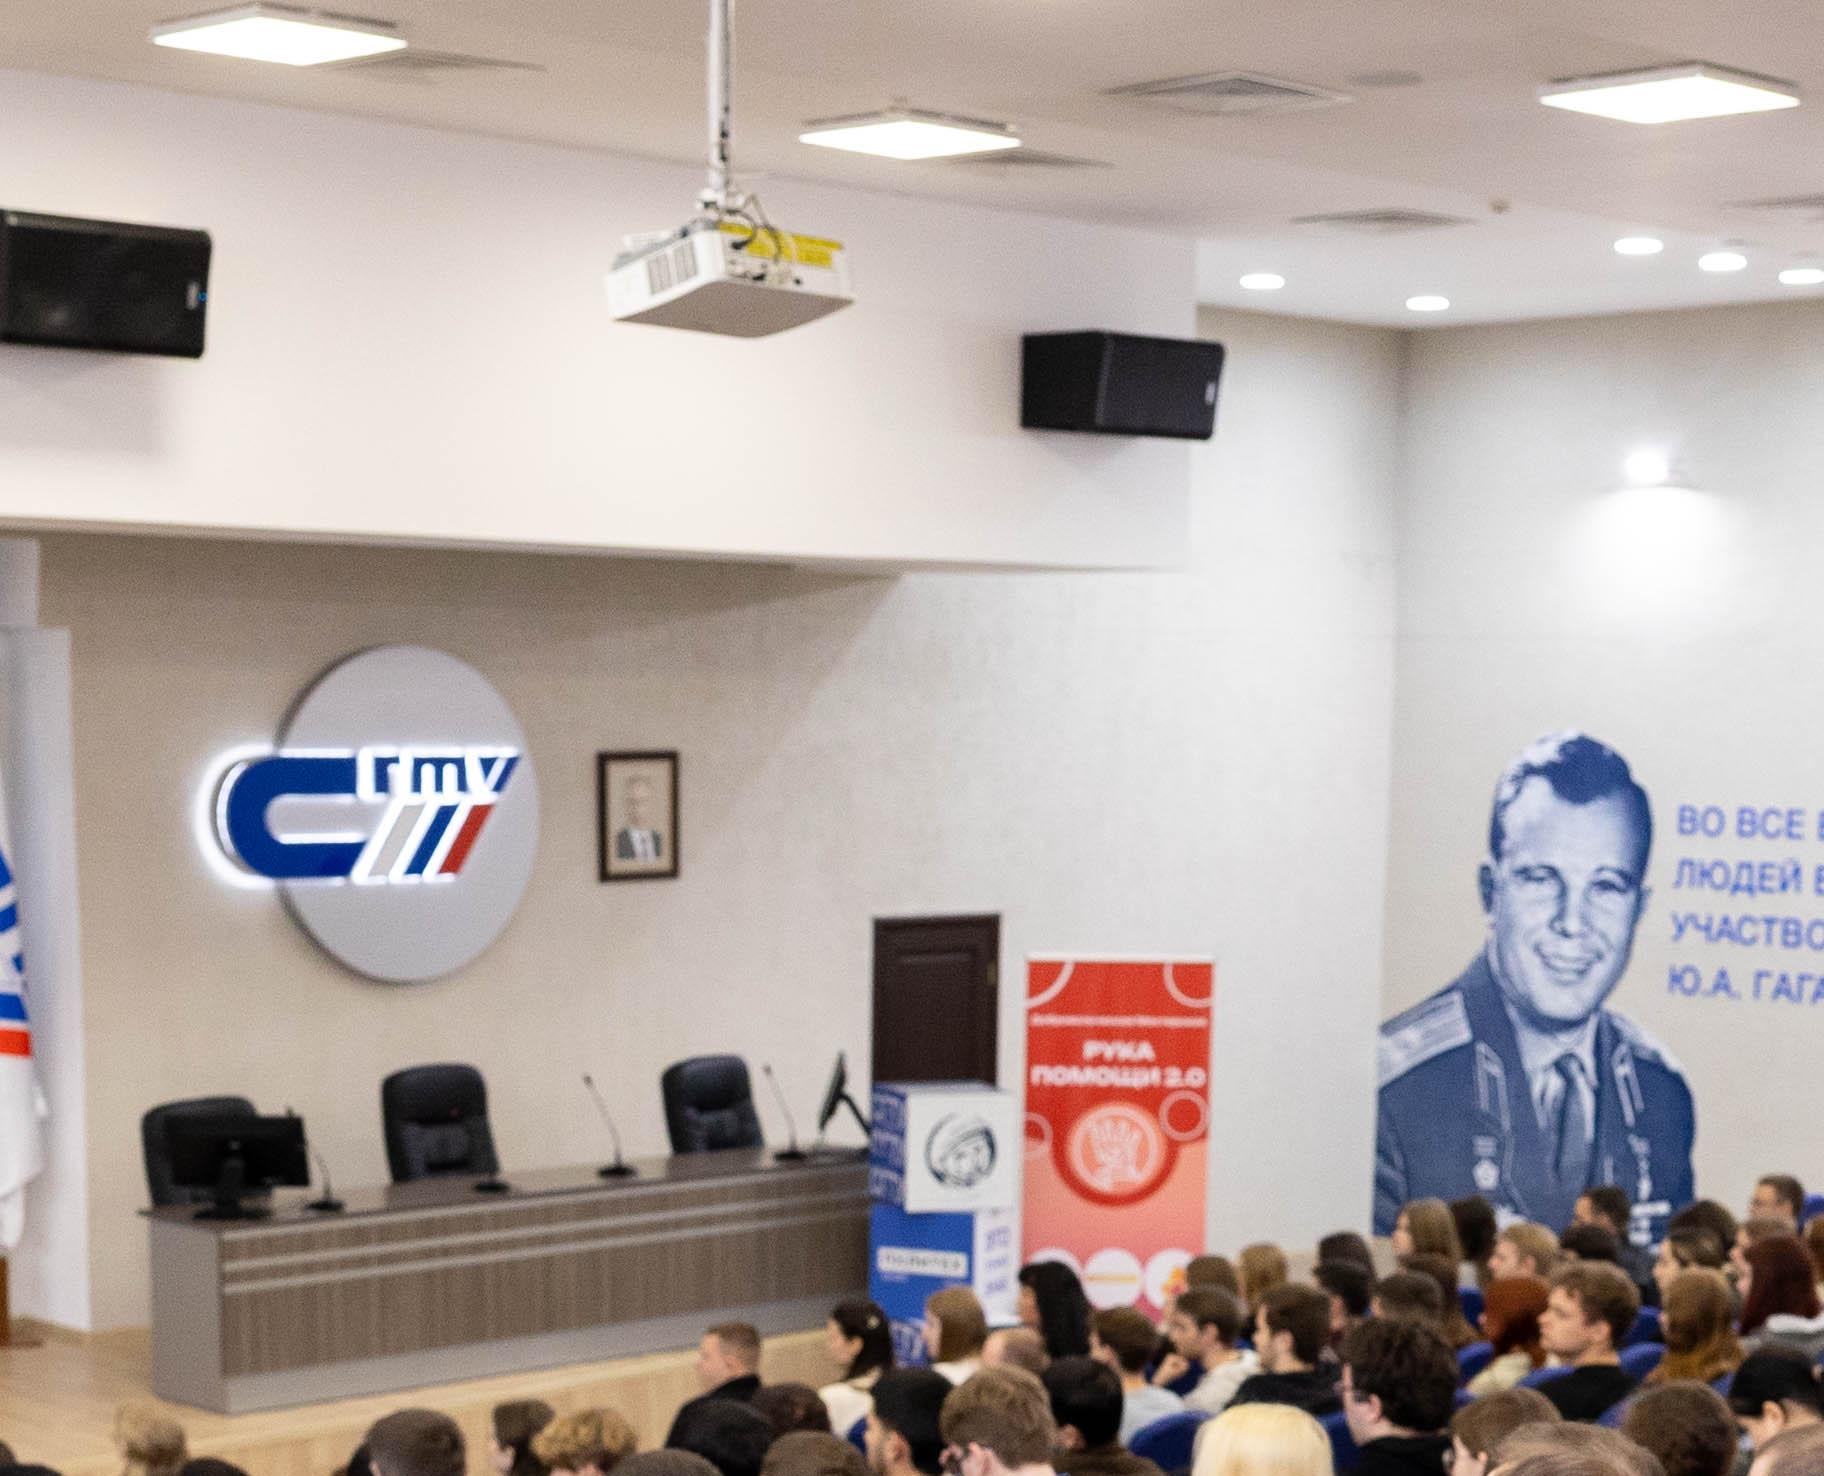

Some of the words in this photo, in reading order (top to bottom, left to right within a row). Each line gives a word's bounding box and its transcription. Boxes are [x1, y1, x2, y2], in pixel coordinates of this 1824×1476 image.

[1677, 804, 1727, 838] ВО
[1736, 806, 1806, 842] ВСЕ
[1672, 856, 1803, 897] ЛЮДЕЙ
[1668, 964, 1742, 1000] Ю.А.
[1082, 1040, 1156, 1062] РУКА
[1031, 1065, 1161, 1089] ПОМОЩИ
[1163, 1067, 1207, 1088] 2.0
